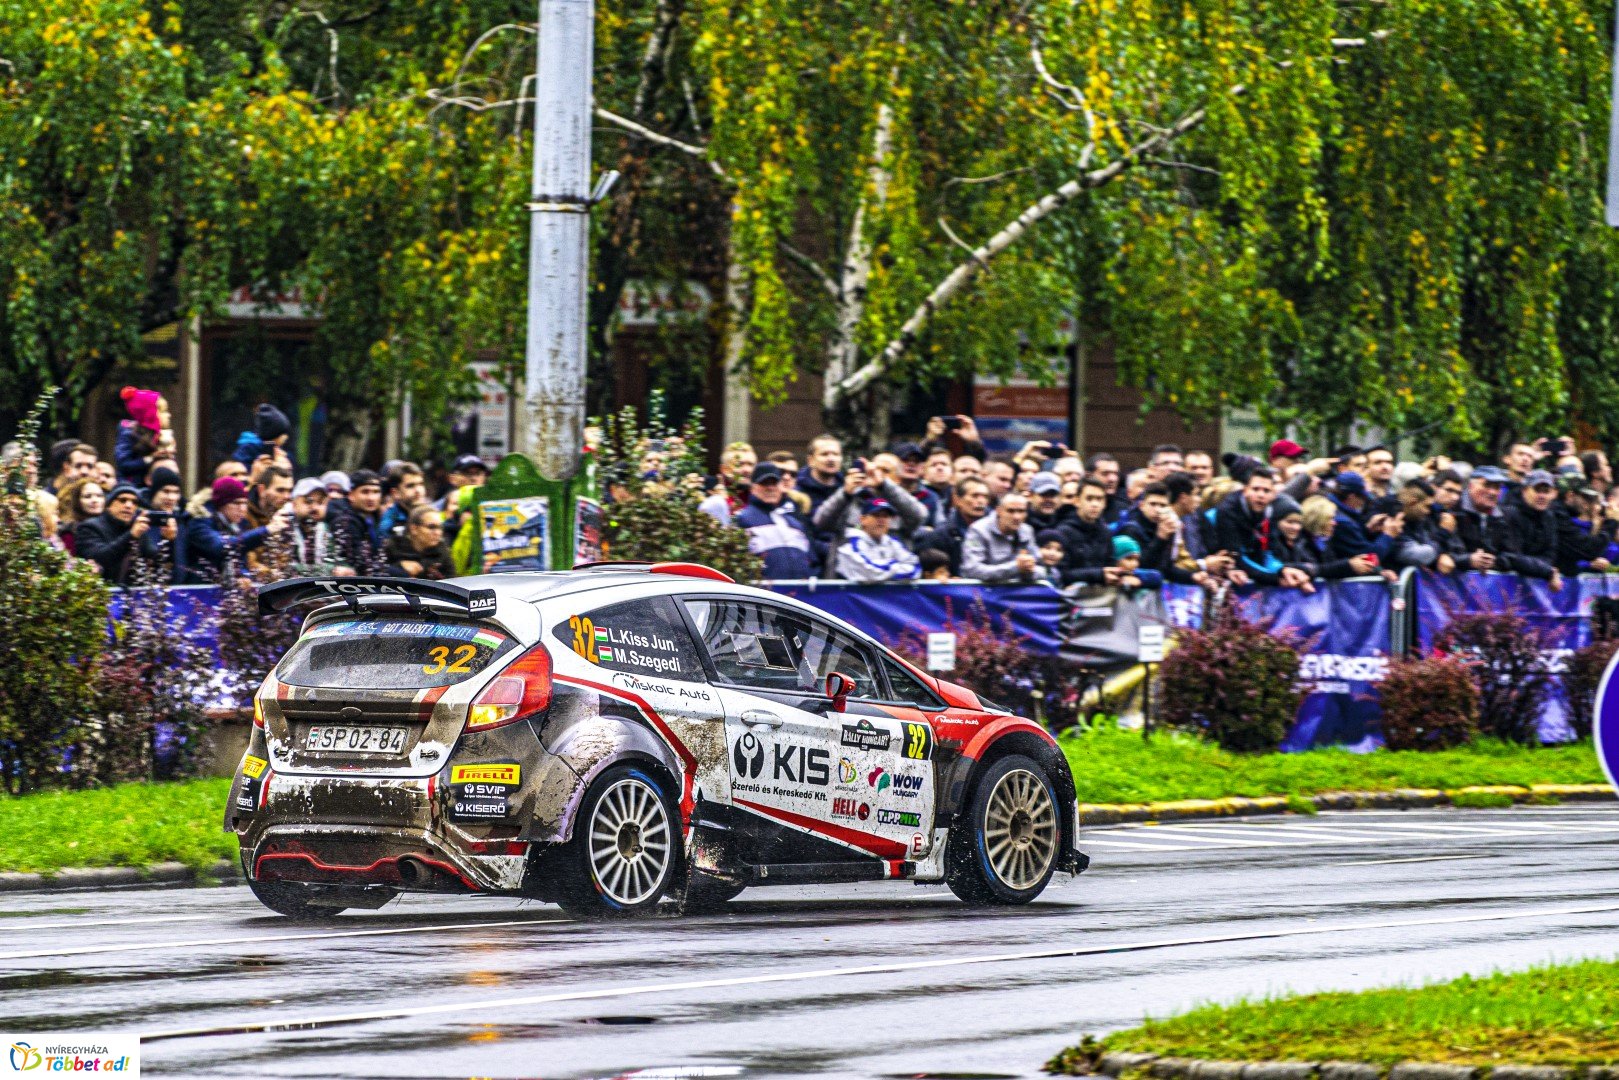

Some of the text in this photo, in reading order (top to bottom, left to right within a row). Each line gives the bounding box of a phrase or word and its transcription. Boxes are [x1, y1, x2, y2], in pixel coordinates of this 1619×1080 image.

[470, 597, 495, 608] DAF
[382, 622, 471, 638] GOT TALENT? PROVE IT!
[570, 614, 599, 664] 32
[609, 628, 679, 652] L.Kiss Jun.
[422, 644, 477, 674] 32
[614, 648, 681, 673] M.Szegedi
[623, 678, 710, 701] Miskolc Autó
[321, 728, 401, 750] SP 02-84
[842, 729, 861, 743] RALLY
[907, 723, 926, 759] 32
[458, 768, 513, 780] PIRELLI
[774, 743, 829, 786] KIS
[476, 784, 506, 795] SVIP
[732, 780, 828, 801] Szerelő és Kereskedő Kft.
[893, 774, 923, 790] WOW
[893, 789, 918, 798] HUNGARY
[465, 802, 506, 814] KISERŐ
[832, 797, 856, 816] HELL
[914, 836, 922, 853] E
